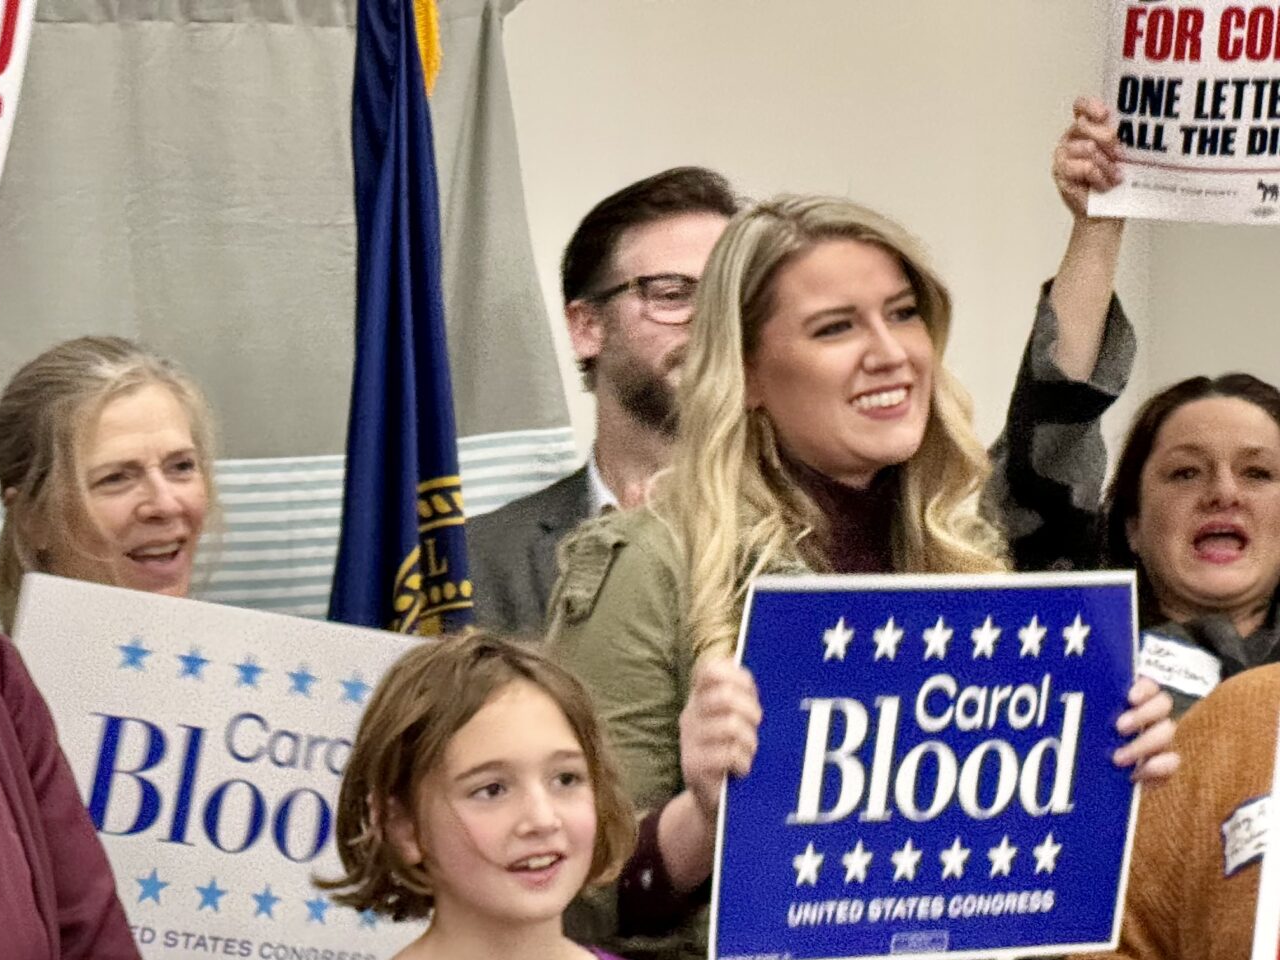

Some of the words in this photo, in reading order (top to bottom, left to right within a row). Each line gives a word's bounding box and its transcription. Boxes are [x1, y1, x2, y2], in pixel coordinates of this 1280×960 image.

[1123, 5, 1204, 62] FOR
[1217, 5, 1280, 62] CO
[1117, 74, 1183, 119] ONE
[1117, 120, 1168, 152] ALL
[1180, 125, 1237, 156] THE
[915, 673, 1052, 732] Carol
[225, 712, 353, 776] Caro
[786, 691, 1084, 824] Blood
[89, 712, 332, 863] Bloo
[788, 899, 863, 928] UNITED
[867, 894, 944, 922] STATES
[948, 890, 1055, 918] CONGRESS
[163, 930, 253, 957] STATES
